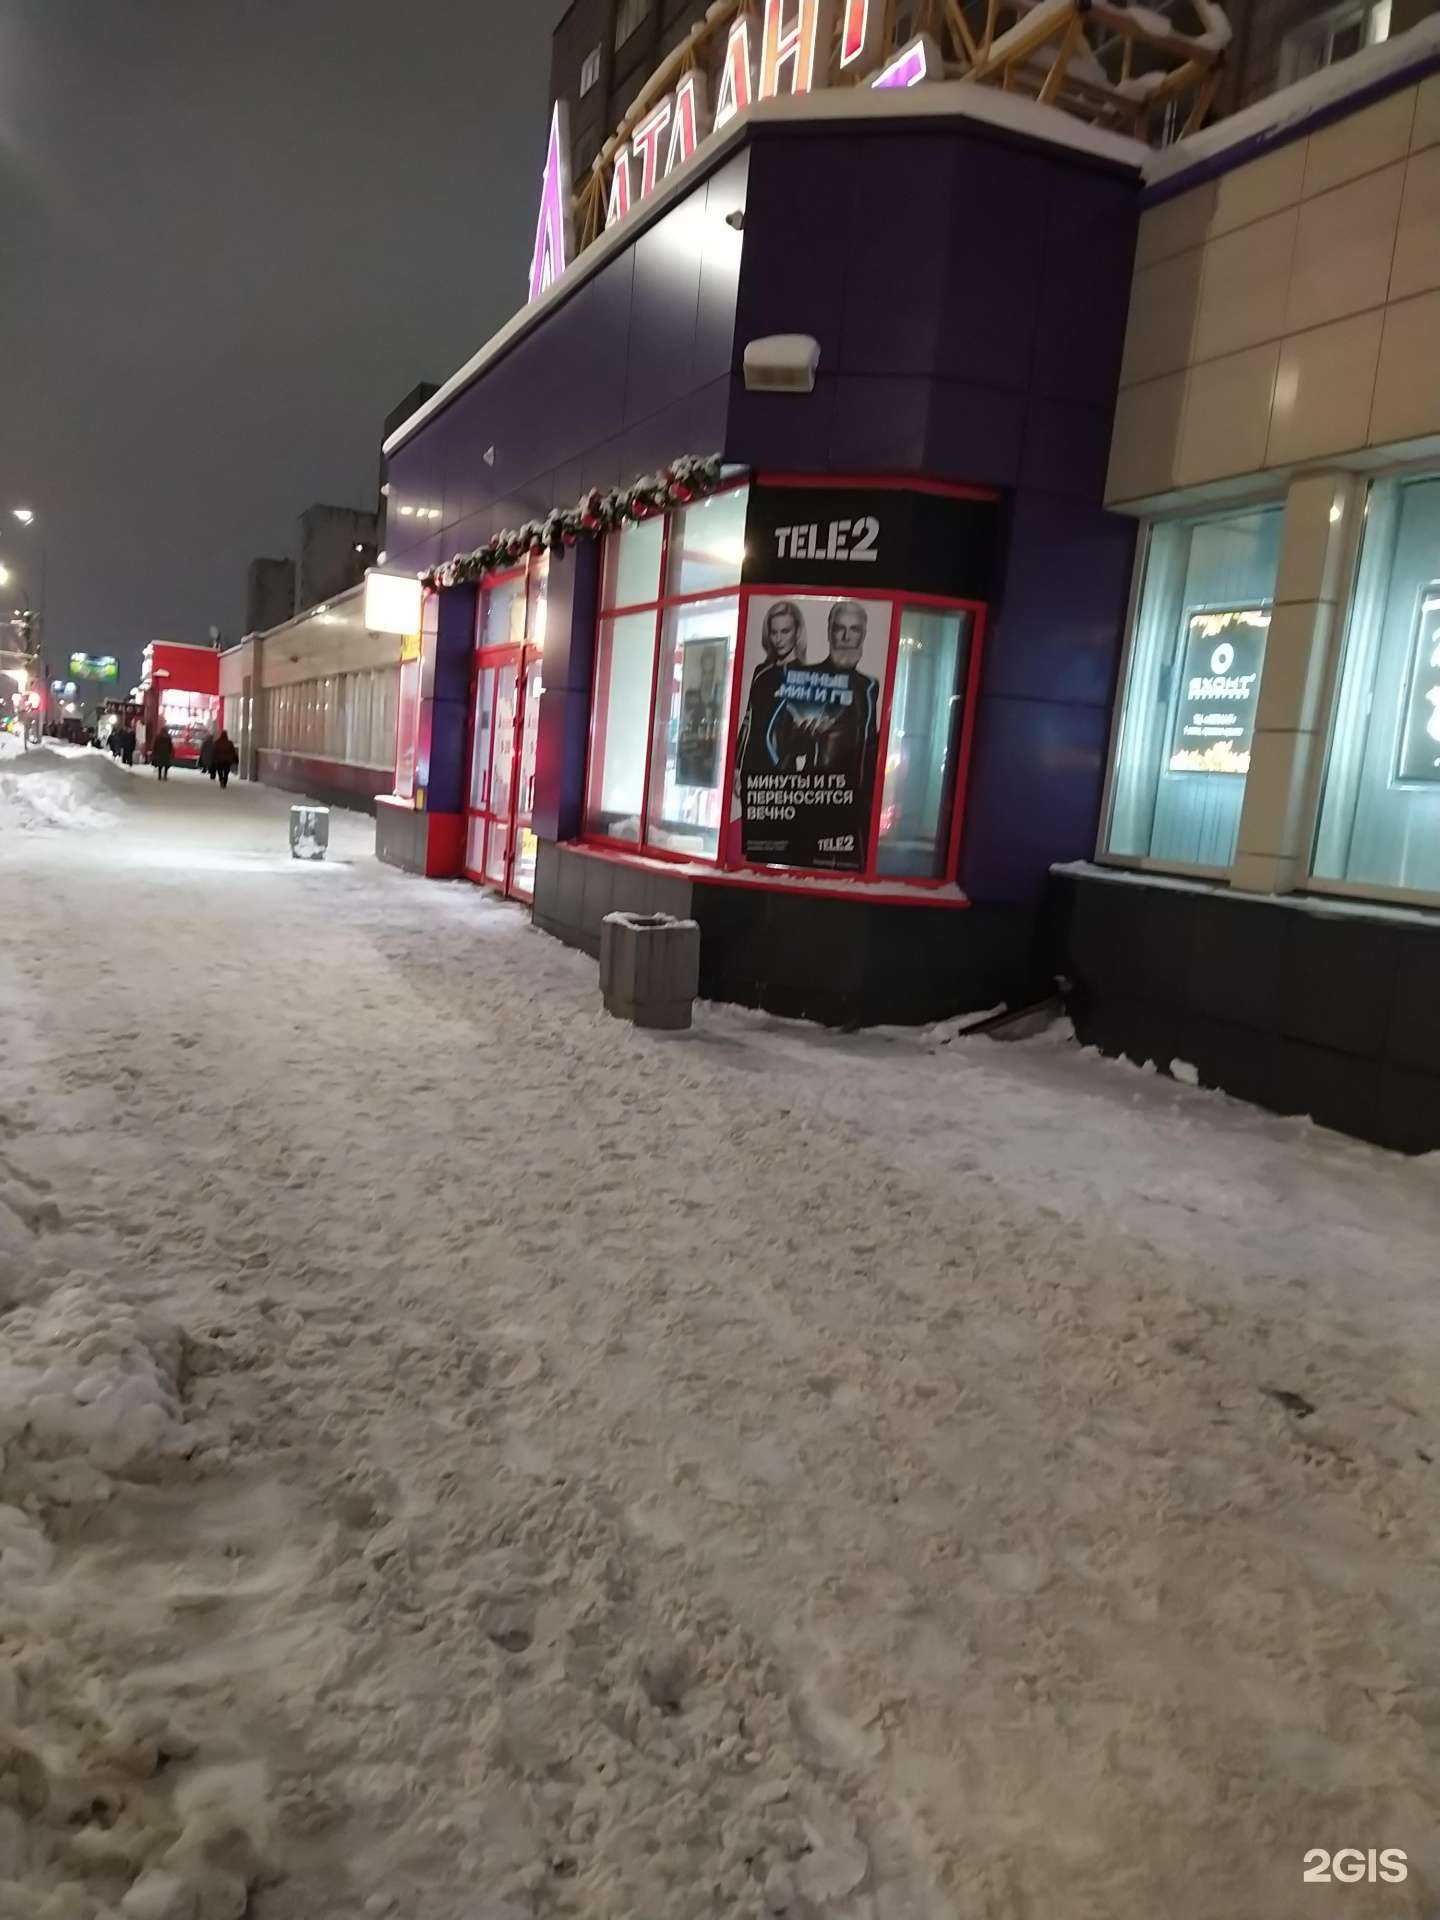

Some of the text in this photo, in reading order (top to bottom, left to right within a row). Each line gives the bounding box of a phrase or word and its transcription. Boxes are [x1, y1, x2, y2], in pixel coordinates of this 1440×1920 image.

[775, 516, 880, 561] TELE2
[747, 774, 846, 789] МИНУТЫ И ГБ
[747, 790, 854, 805] ПЕРЕНОСЯТСЯ
[747, 806, 796, 820] ВЕЧНО
[818, 835, 854, 851] TELE2
